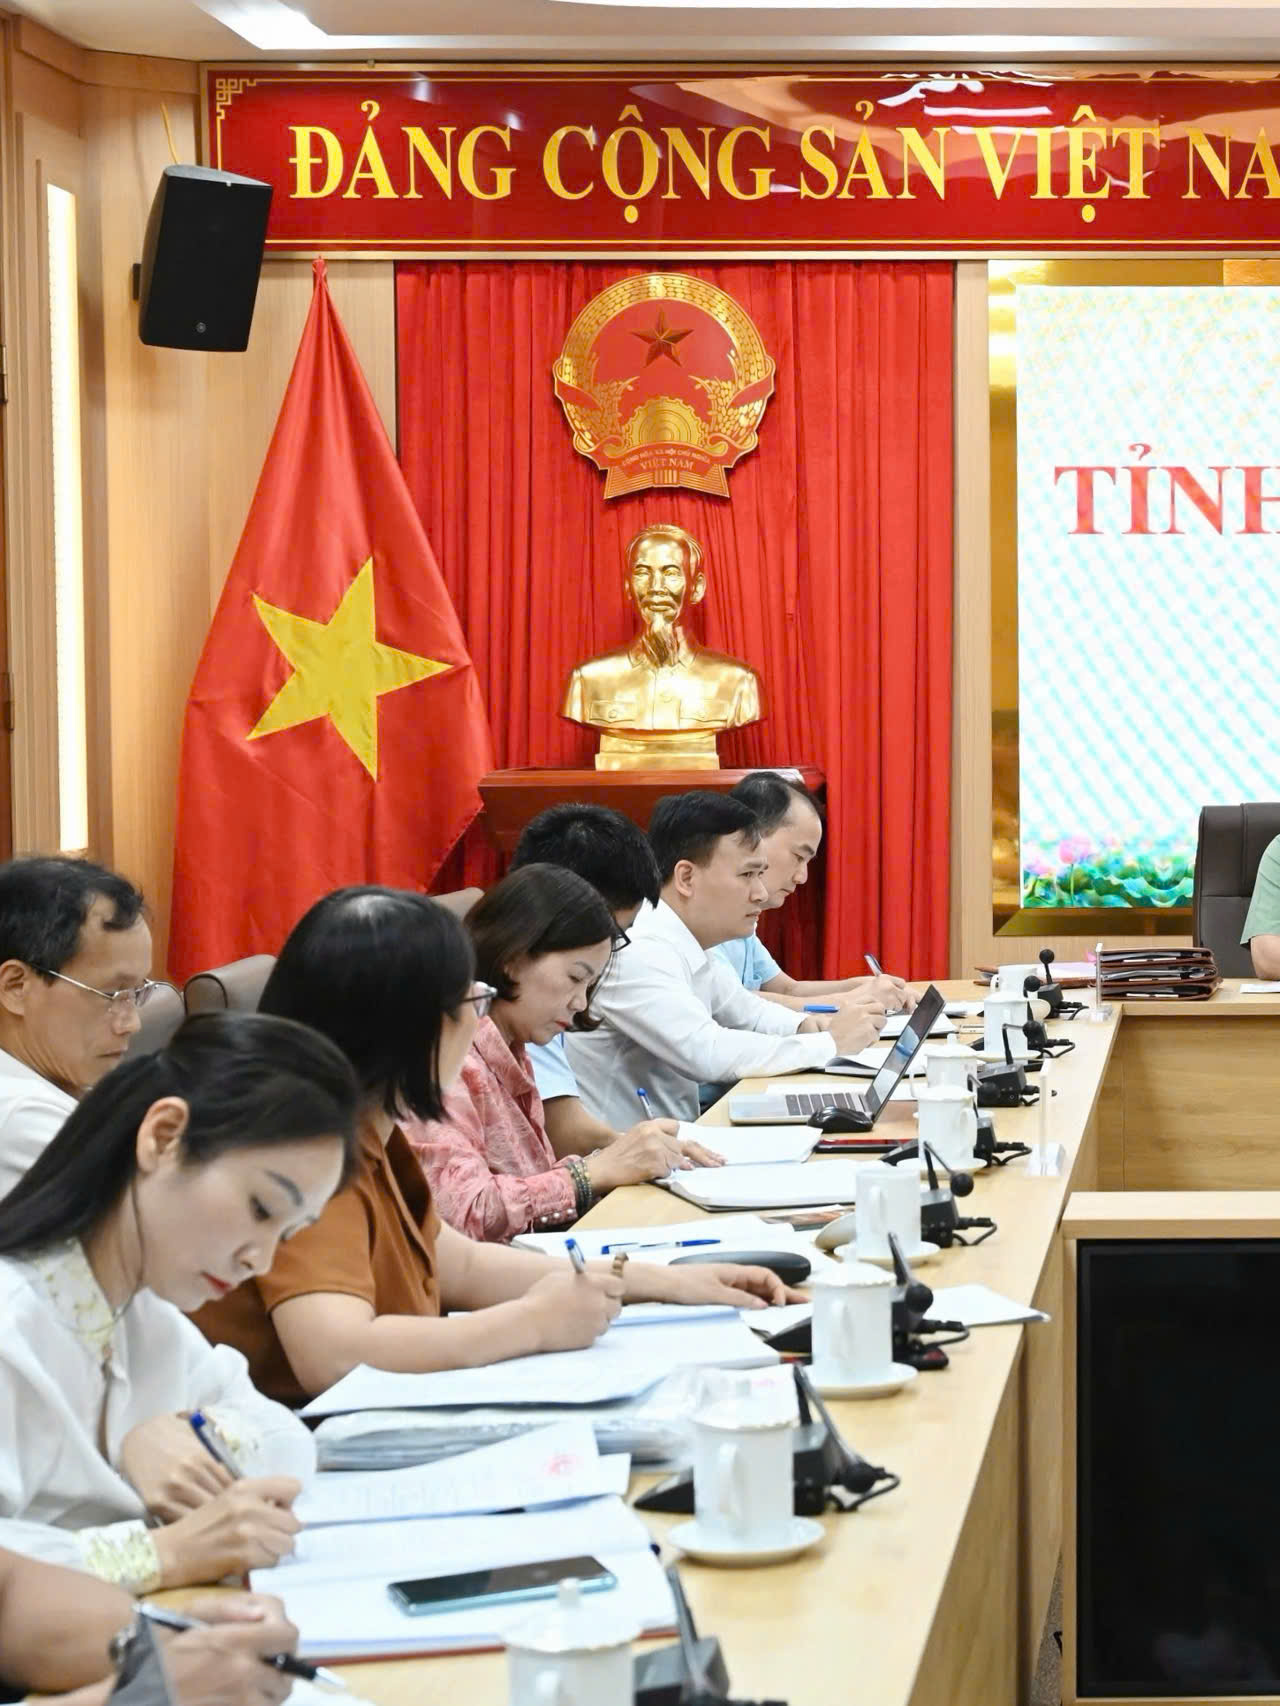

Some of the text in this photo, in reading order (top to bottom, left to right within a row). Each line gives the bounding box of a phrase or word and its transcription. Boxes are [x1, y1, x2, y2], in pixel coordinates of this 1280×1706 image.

[288, 100, 517, 200] ĐẢNG
[543, 104, 774, 224] CỘNG
[799, 100, 954, 200] SẢN
[973, 104, 1161, 223] VIỆT
